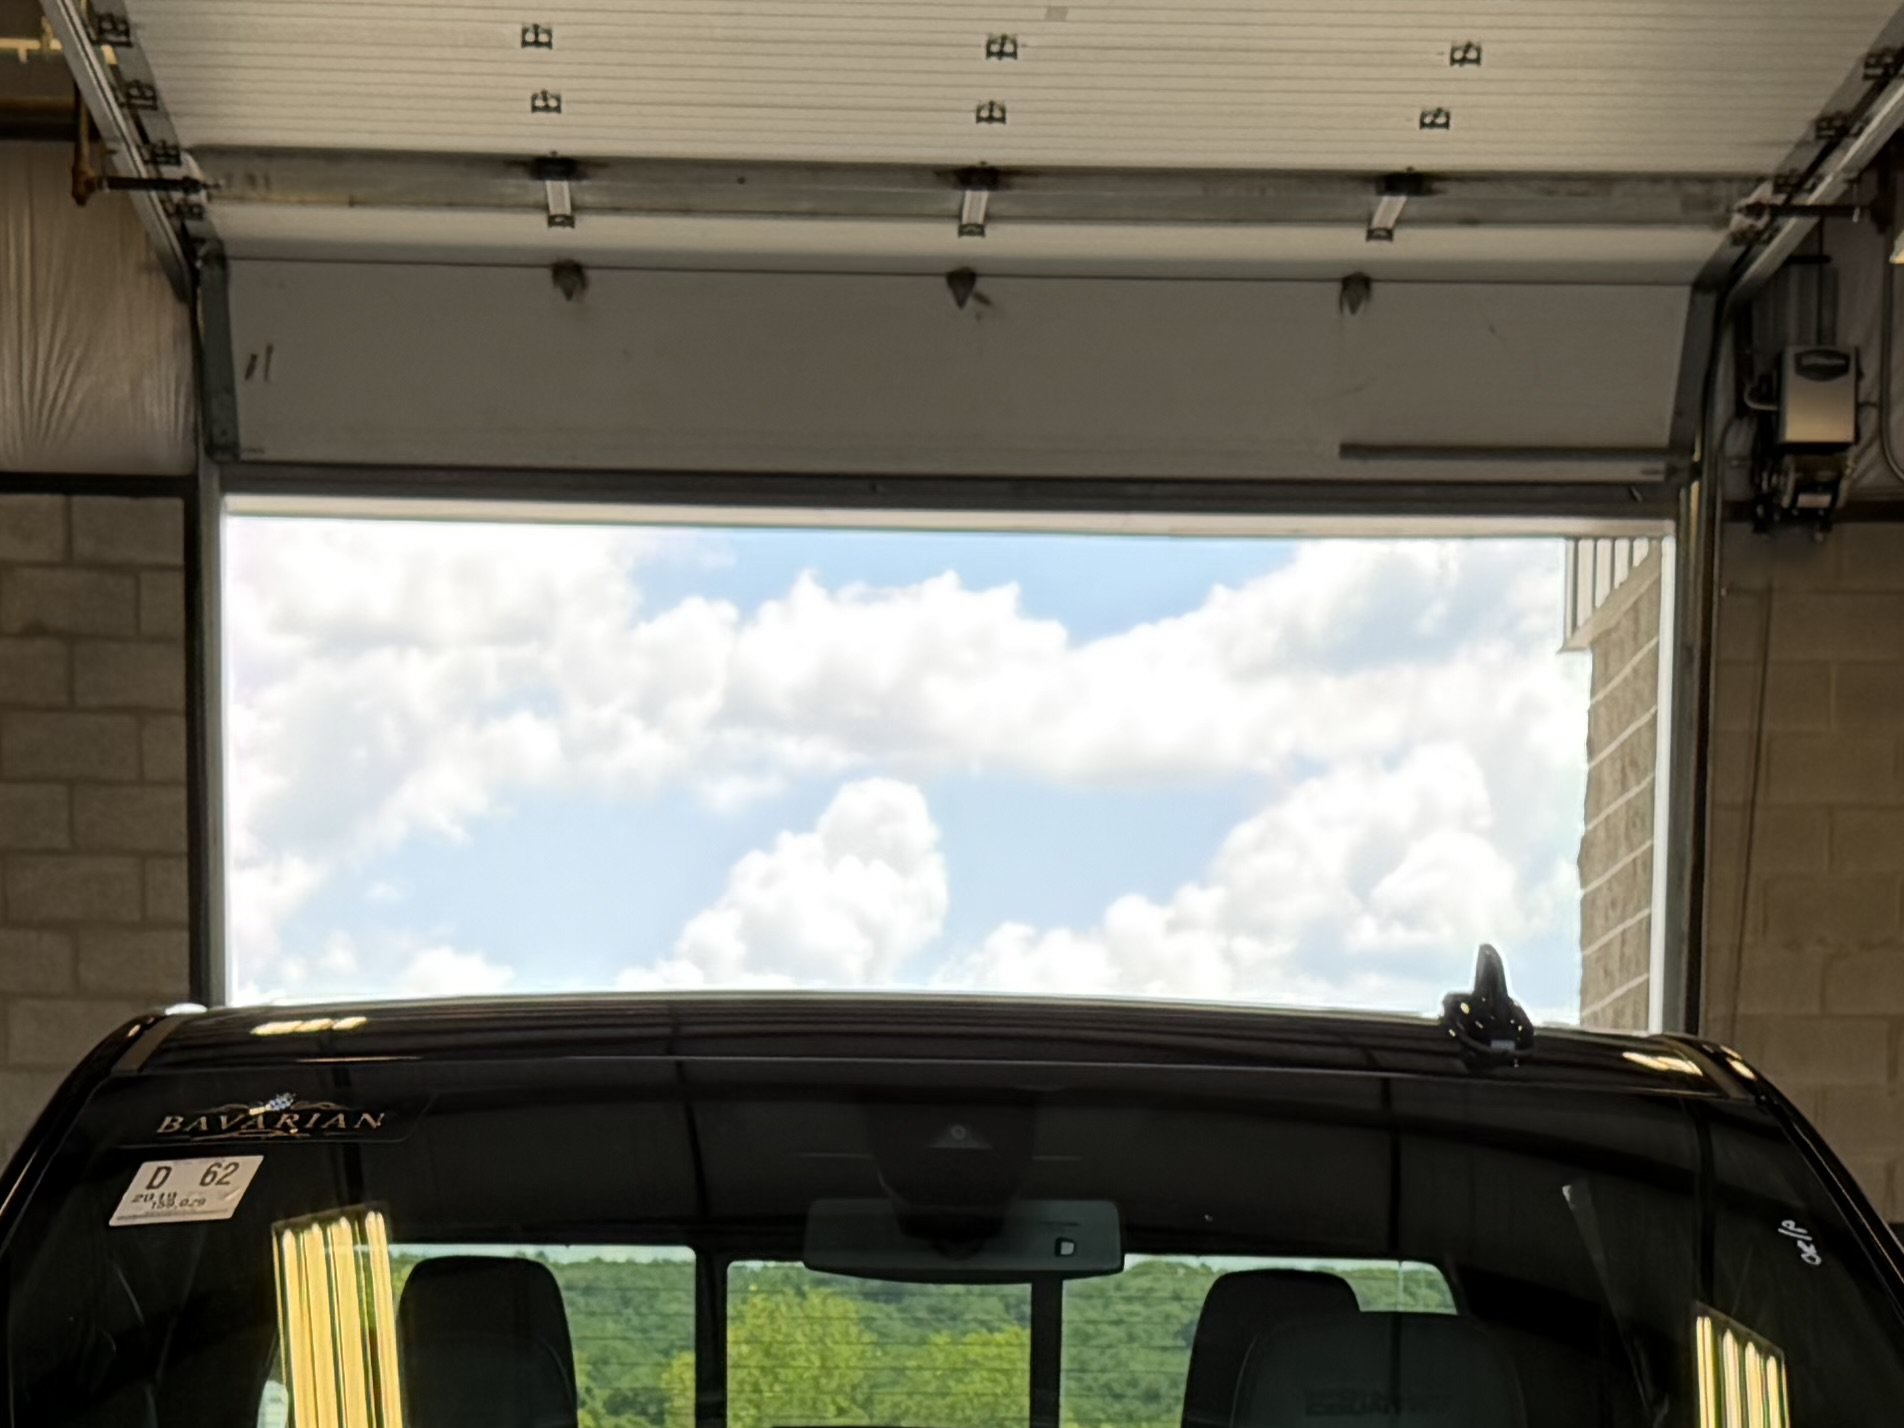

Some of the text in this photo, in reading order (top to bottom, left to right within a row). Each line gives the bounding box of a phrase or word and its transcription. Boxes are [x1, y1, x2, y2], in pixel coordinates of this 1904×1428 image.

[157, 1112, 385, 1134] BAVARIAN
[146, 1161, 240, 1191] D 62
